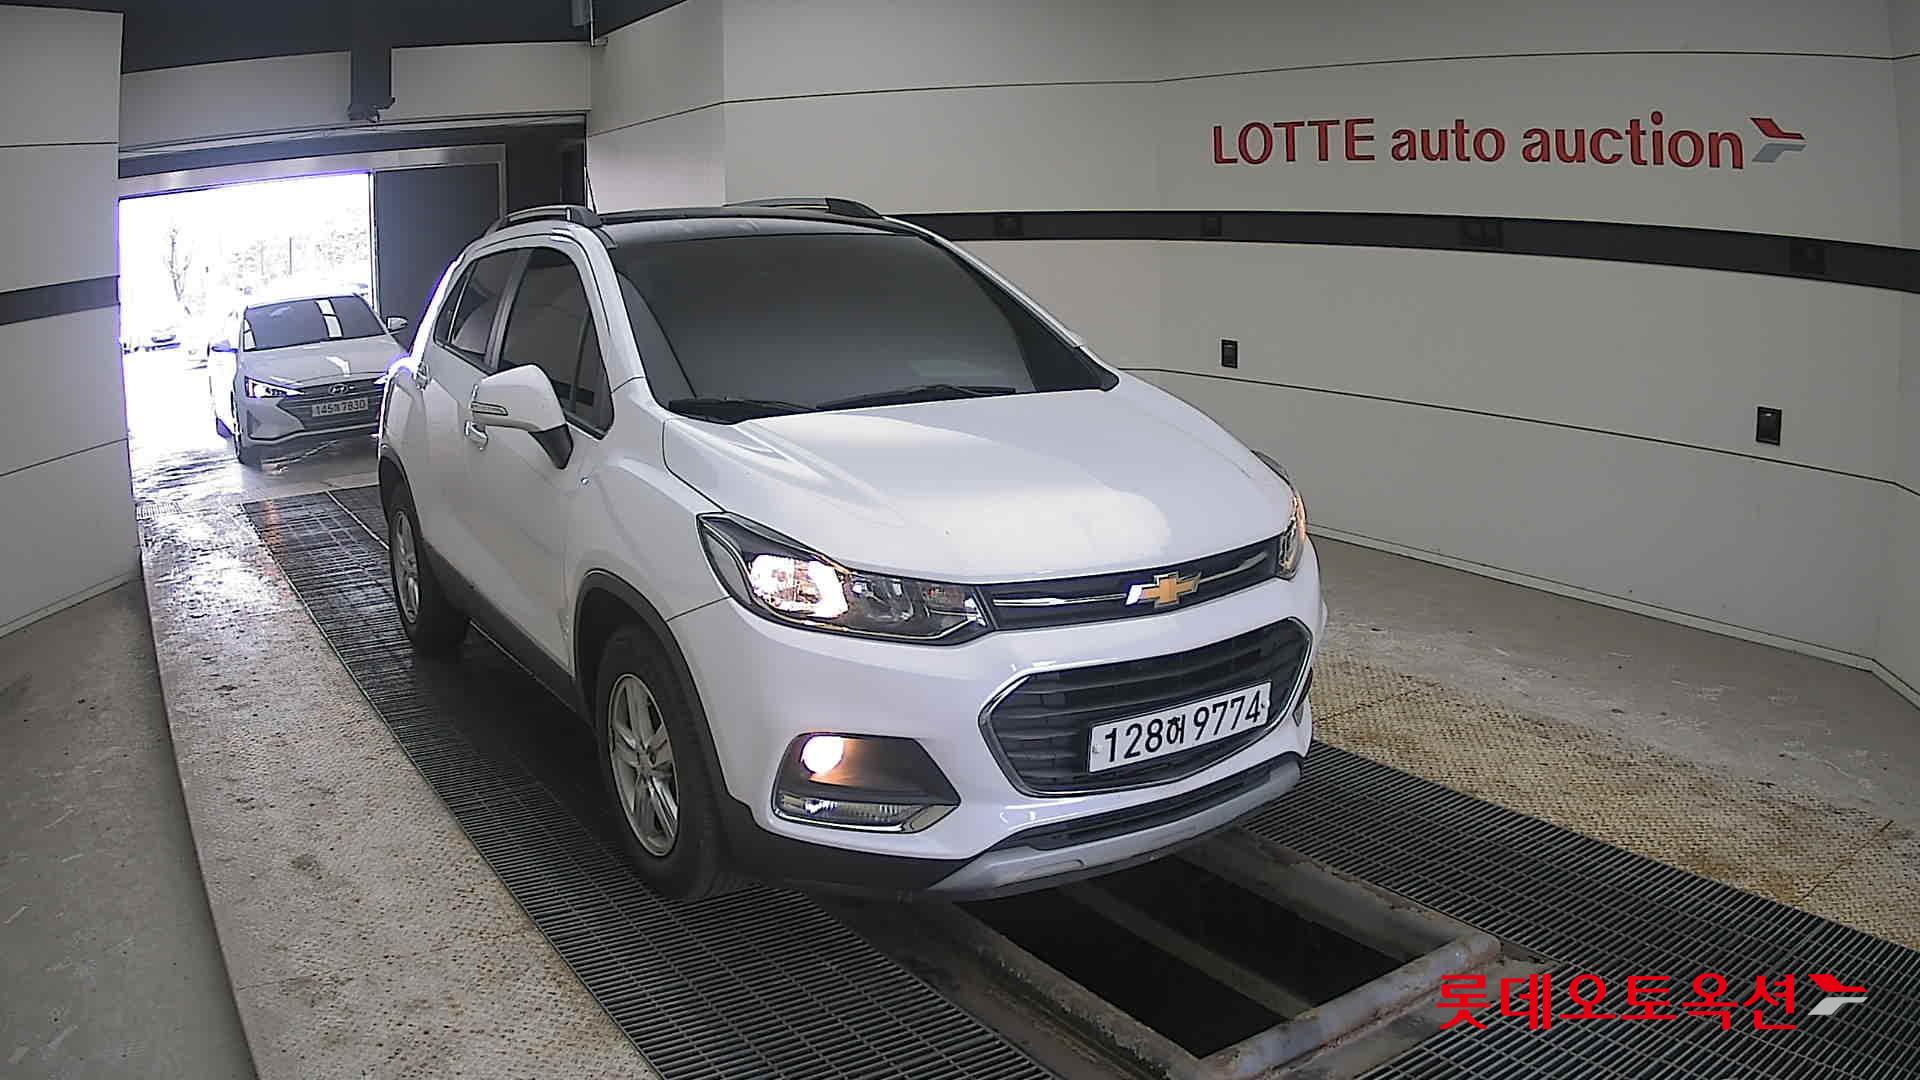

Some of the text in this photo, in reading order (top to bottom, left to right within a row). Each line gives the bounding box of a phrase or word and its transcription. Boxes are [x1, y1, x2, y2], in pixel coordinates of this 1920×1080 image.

[1212, 111, 1745, 170] LOTTE auto auction
[1104, 690, 1261, 763] 128허 9774
